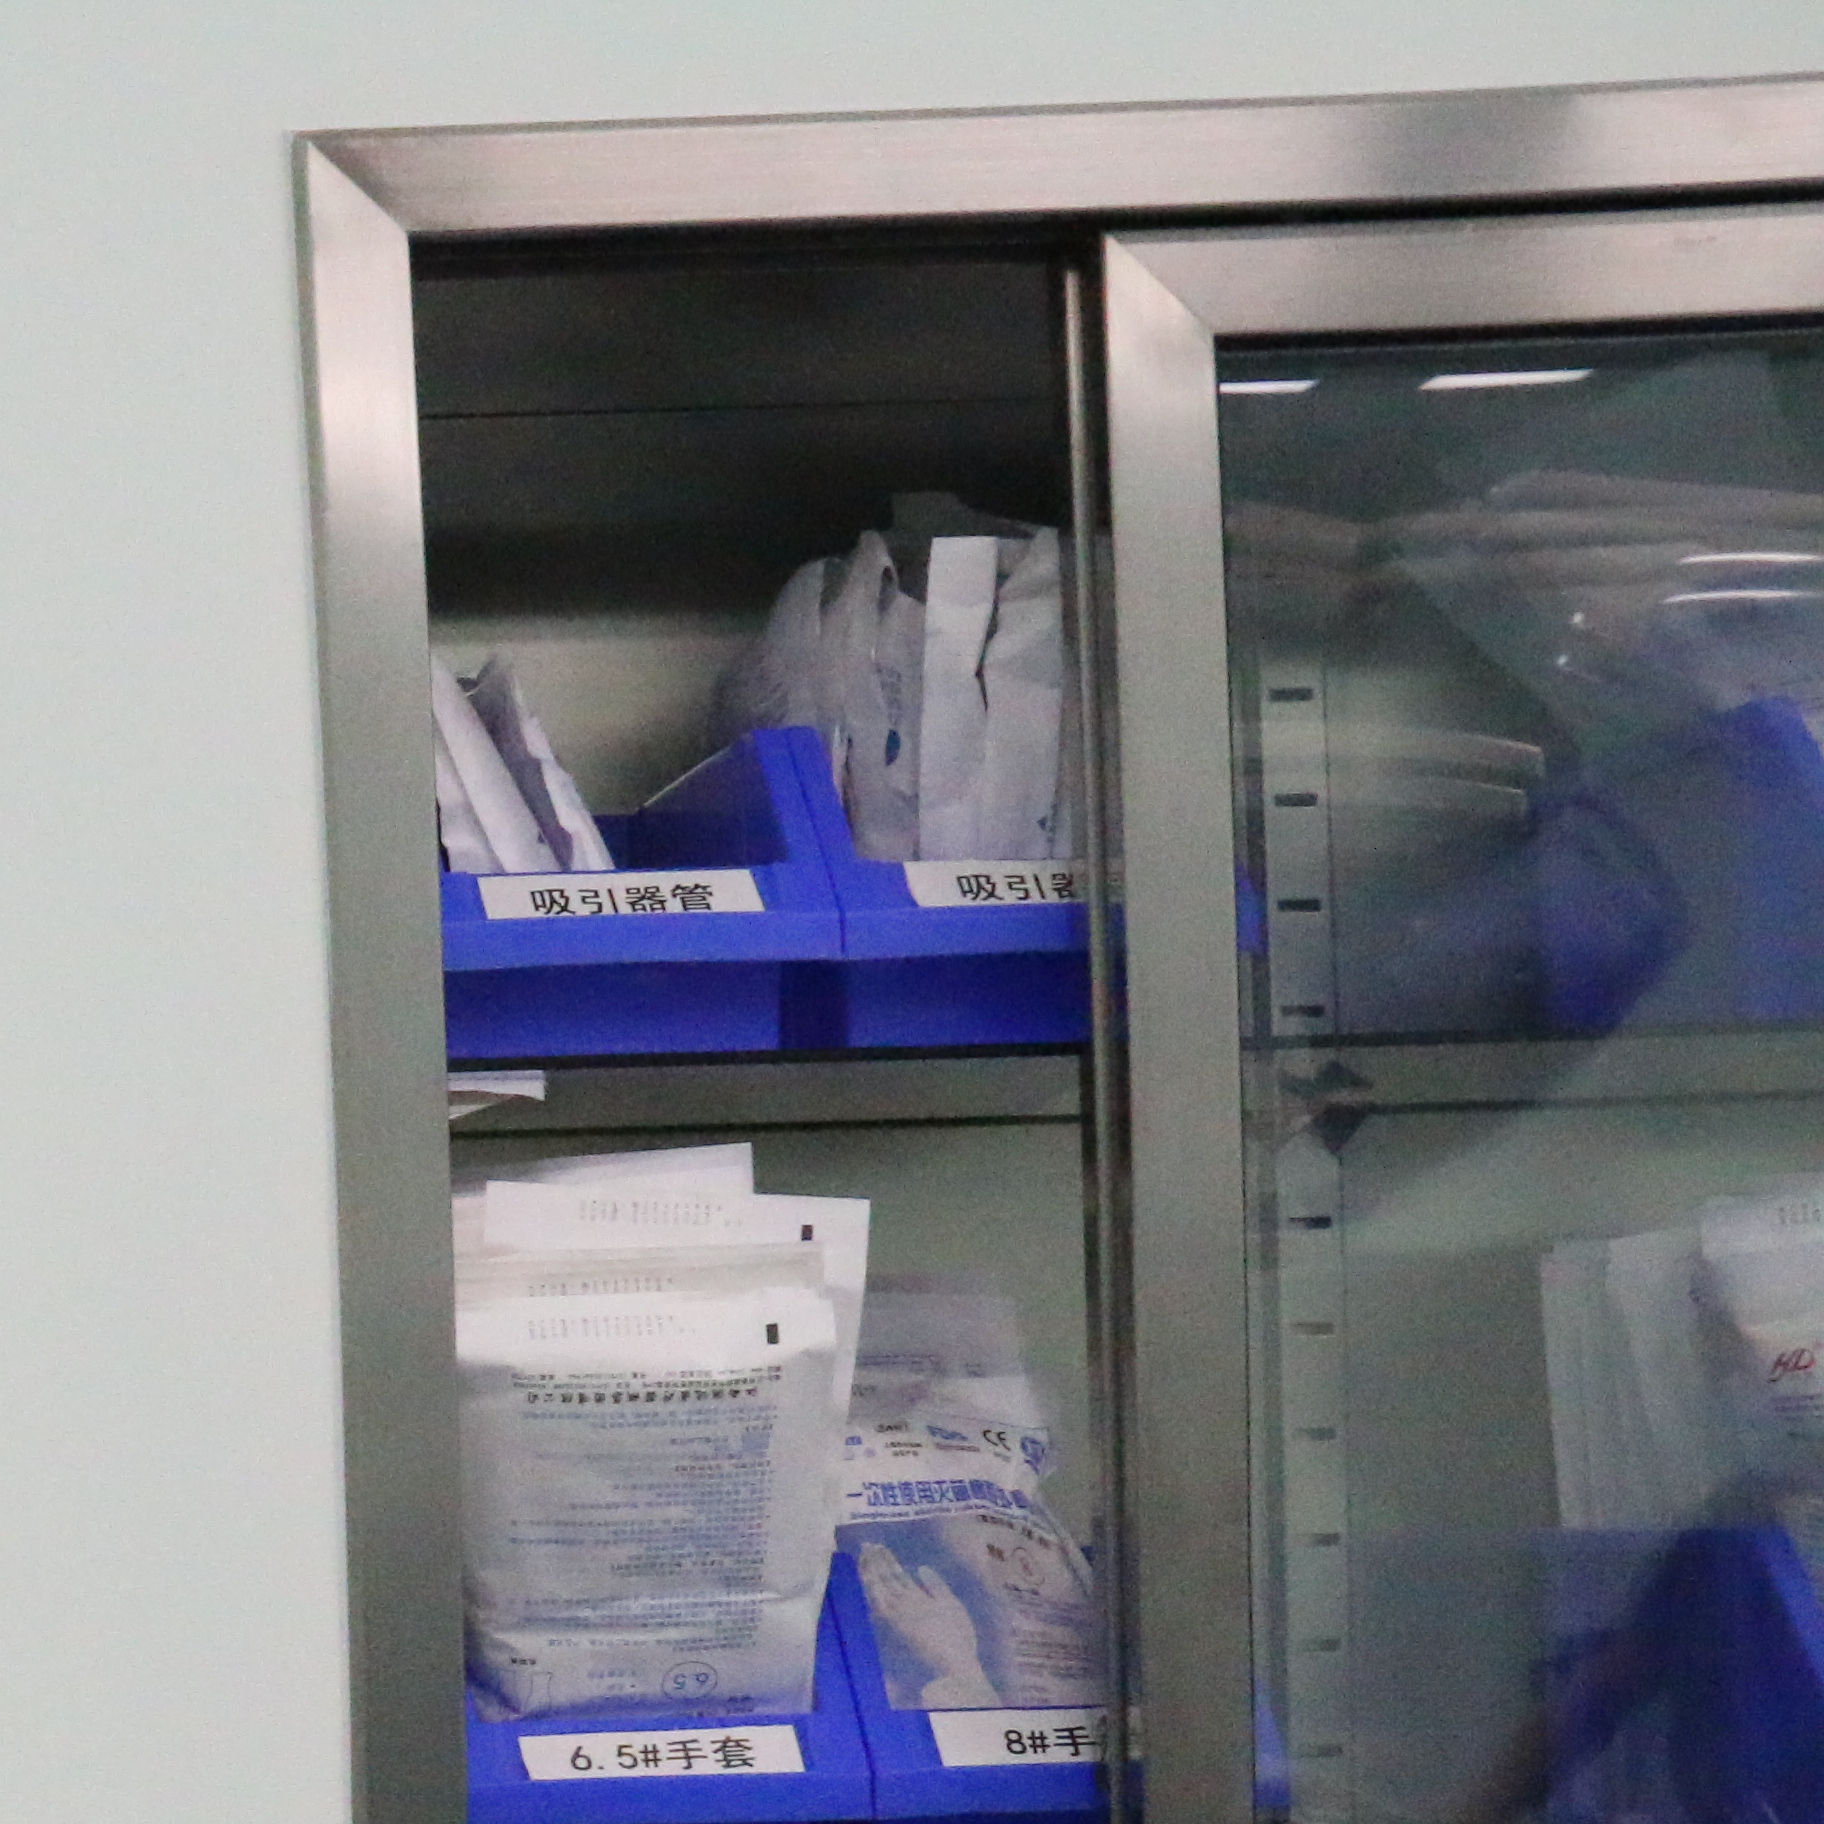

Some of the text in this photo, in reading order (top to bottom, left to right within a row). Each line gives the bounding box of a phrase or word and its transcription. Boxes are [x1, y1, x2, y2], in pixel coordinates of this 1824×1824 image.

[530, 881, 716, 915] 吸引器管
[571, 1736, 757, 1770] 6.5#手套
[1004, 1726, 1100, 1756] 8#手
